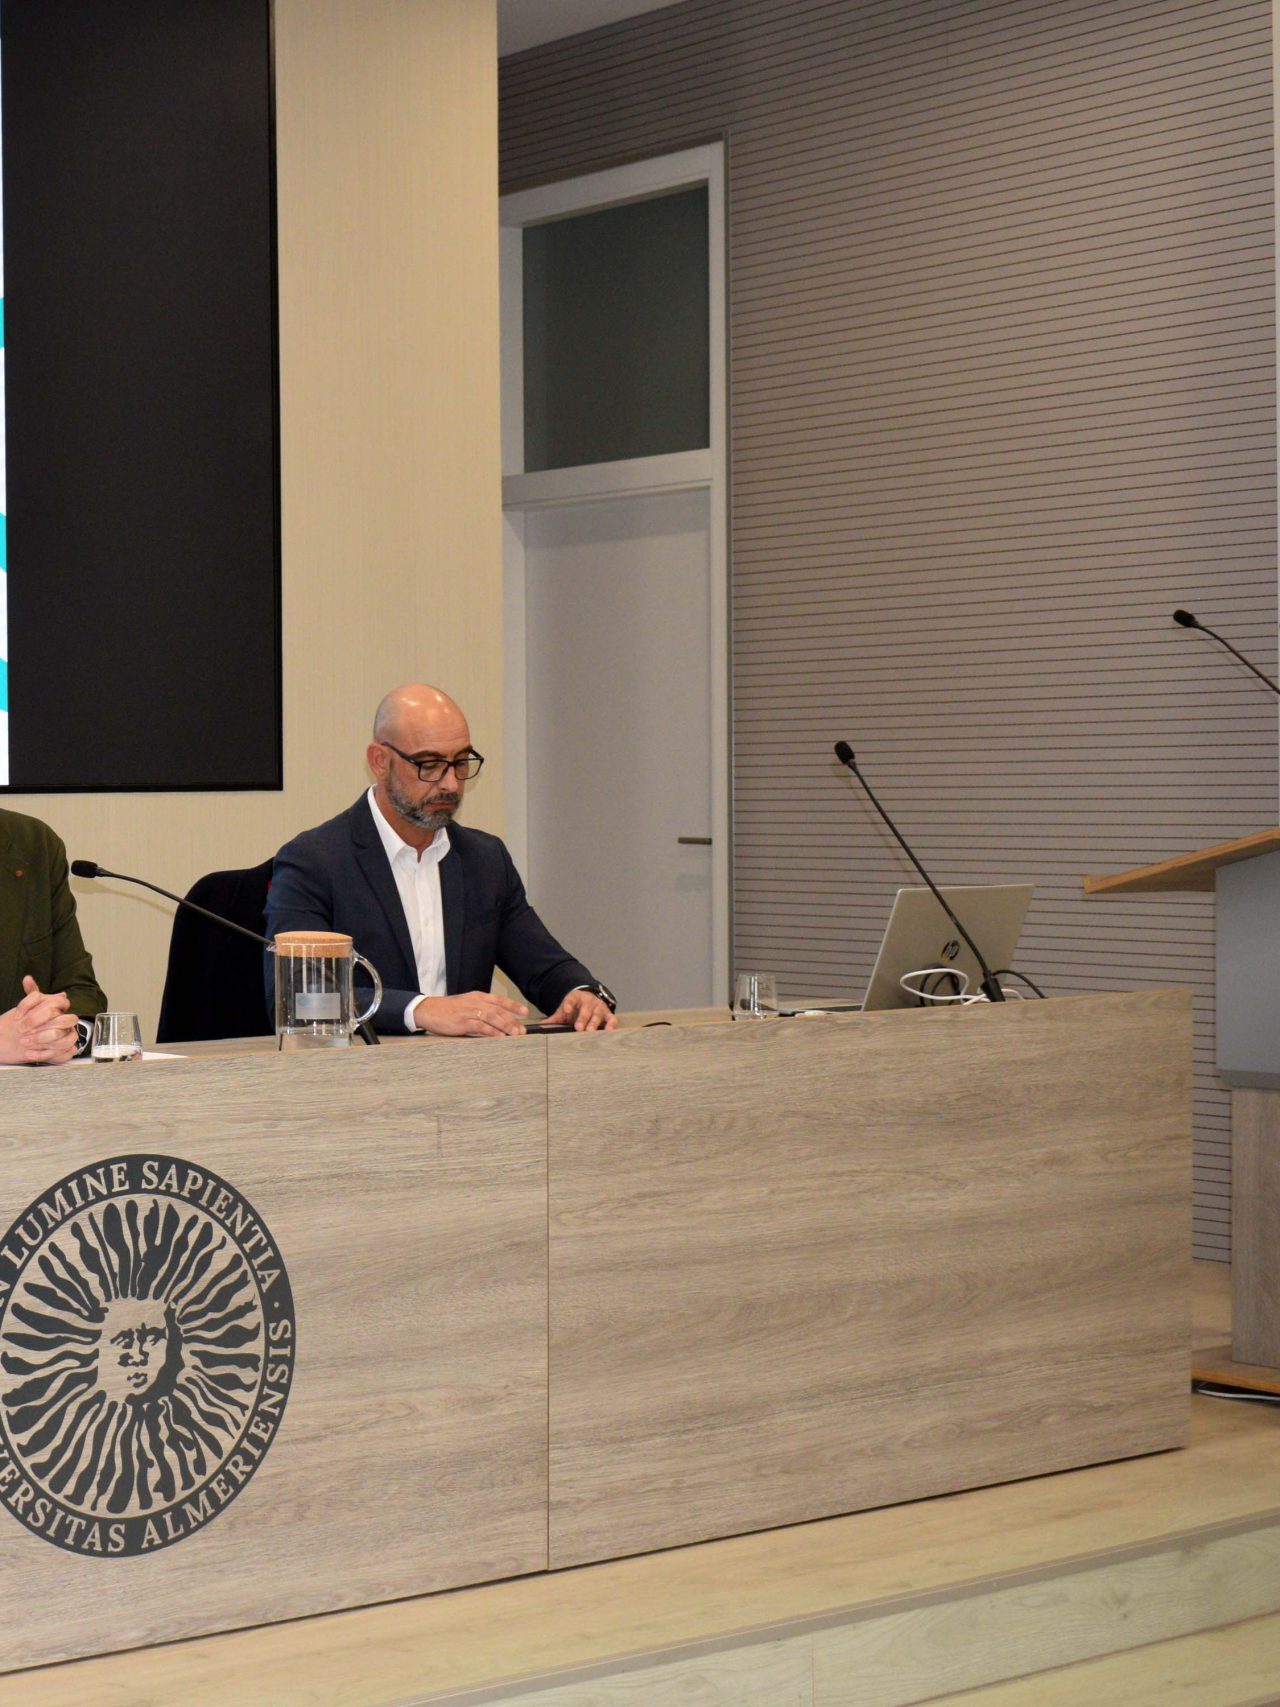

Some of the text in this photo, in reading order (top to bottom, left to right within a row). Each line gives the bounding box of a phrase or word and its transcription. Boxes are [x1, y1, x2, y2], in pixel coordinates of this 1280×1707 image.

[1, 1162, 130, 1270] LUMINE
[140, 1160, 281, 1294] SAPIENTIA
[140, 1318, 292, 1550] ALMERIENSIS
